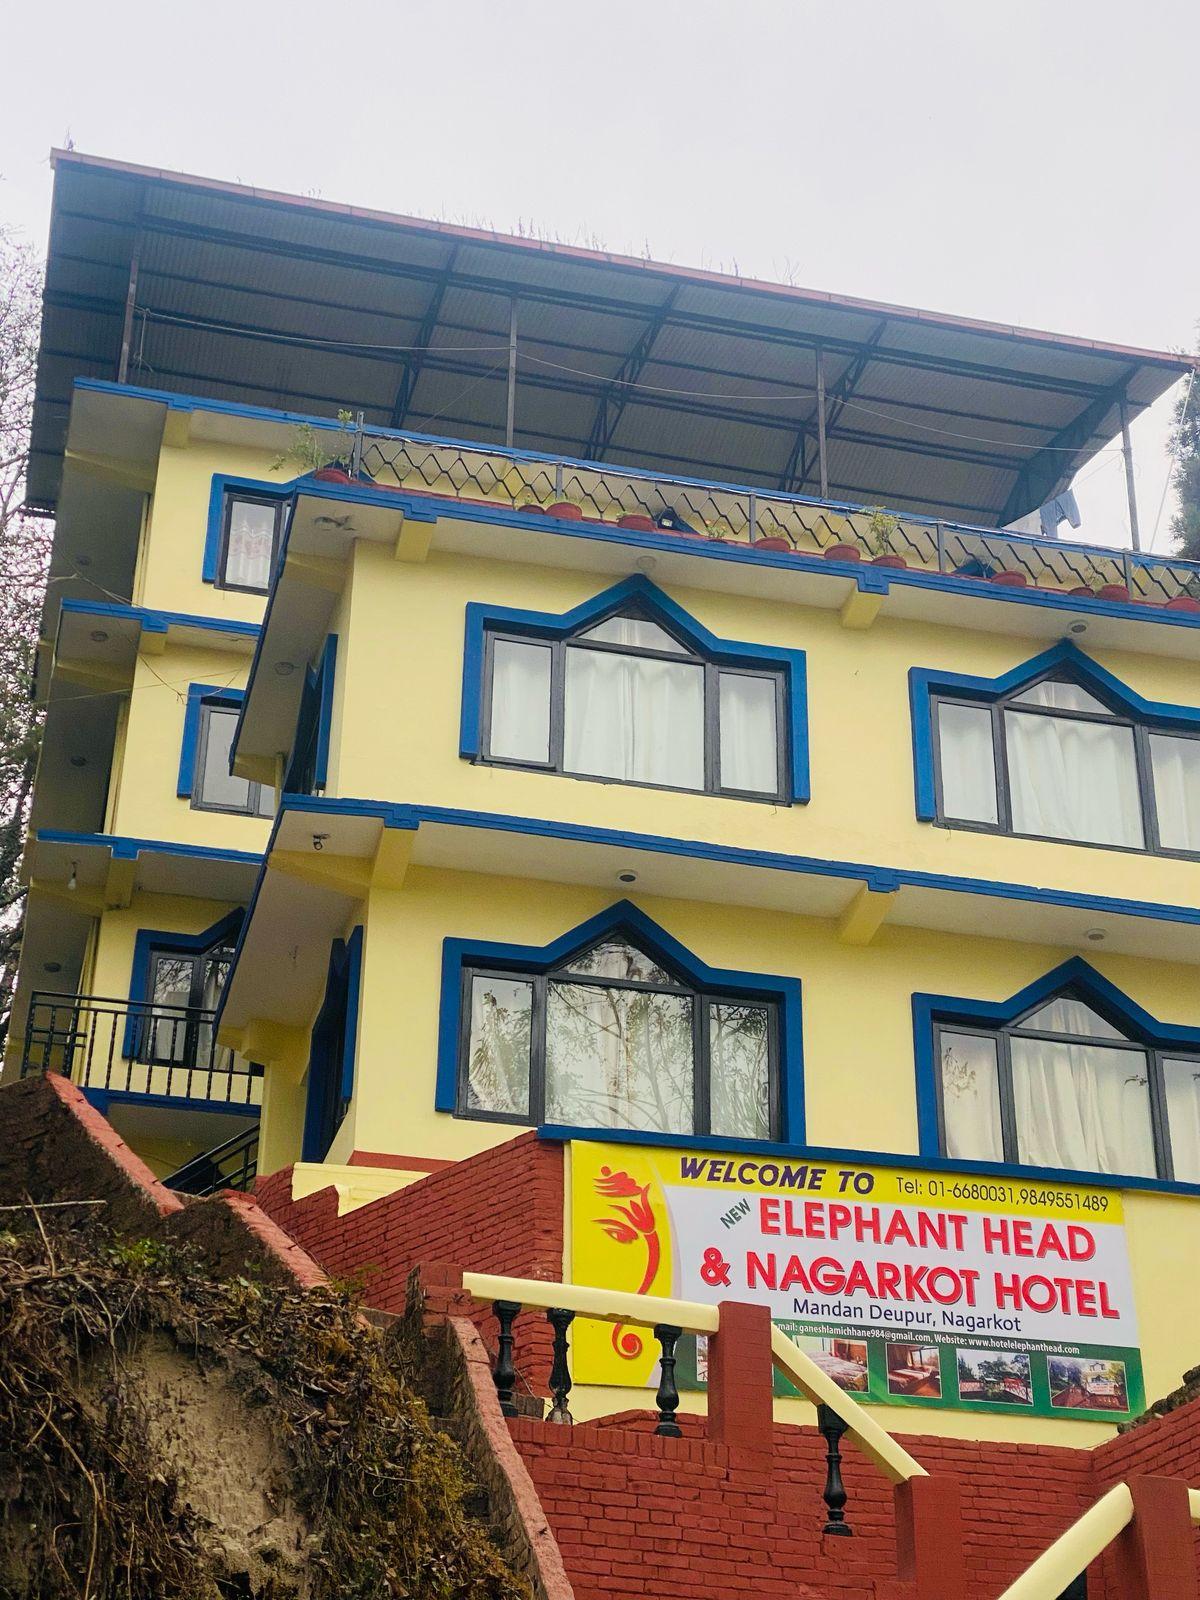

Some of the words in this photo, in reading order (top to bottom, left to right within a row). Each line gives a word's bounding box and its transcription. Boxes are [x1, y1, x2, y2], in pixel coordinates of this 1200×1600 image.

[680, 1156, 827, 1190] WELCOME
[838, 1170, 875, 1195] TO
[896, 1177, 923, 1196] Tel:
[928, 1180, 1109, 1213] 01-6680031,9849551489
[719, 1198, 751, 1230] NEW
[760, 1198, 968, 1252] ELEPHANT
[982, 1217, 1096, 1262] HEAD
[699, 1247, 732, 1288] &
[746, 1251, 980, 1308] NAGARKOT
[993, 1272, 1121, 1320] HOTEL
[793, 1298, 864, 1319] Mandan
[869, 1304, 937, 1327] Deupur,
[942, 1311, 1022, 1333] Nagarkot
[934, 1333, 968, 1346] Website:
[968, 1337, 1080, 1355] www.hotelelephanthead.com
